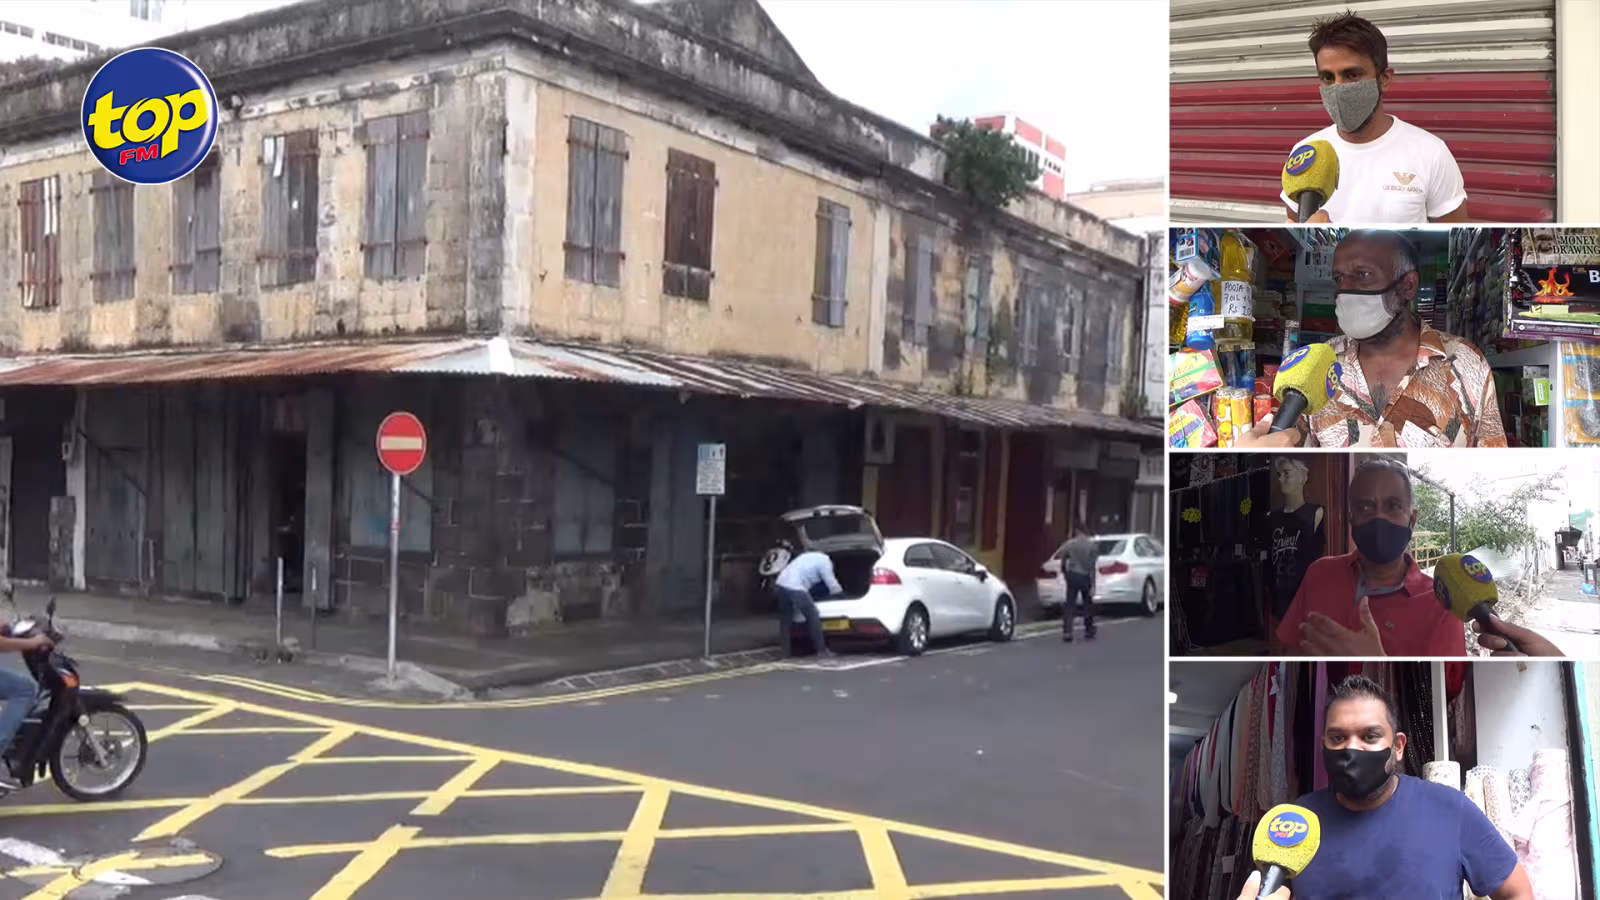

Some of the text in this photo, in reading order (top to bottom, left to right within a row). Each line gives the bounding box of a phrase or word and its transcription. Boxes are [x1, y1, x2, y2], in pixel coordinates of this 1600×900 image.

[1287, 149, 1315, 169] top
[1560, 235, 1596, 245] MONEY
[1552, 245, 1600, 255] DRAWING
[1269, 817, 1308, 837] top
